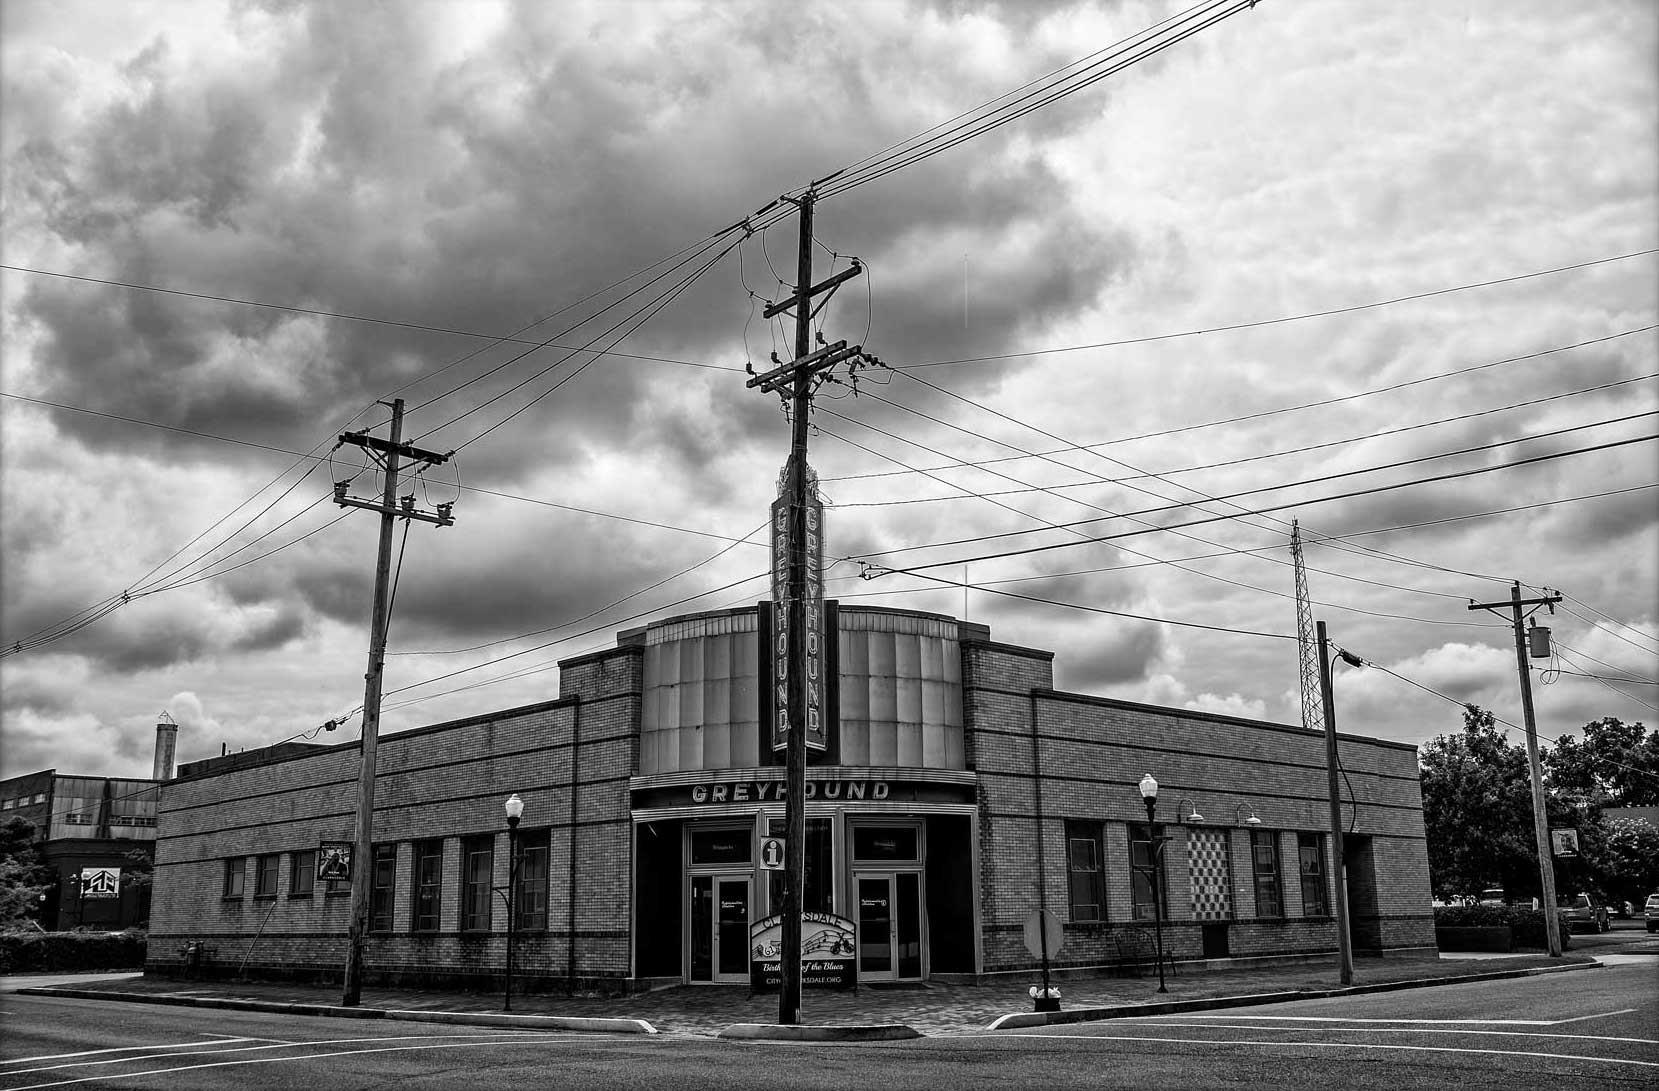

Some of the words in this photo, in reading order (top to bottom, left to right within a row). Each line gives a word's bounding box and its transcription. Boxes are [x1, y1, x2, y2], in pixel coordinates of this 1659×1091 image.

[776, 507, 788, 732] GREYHOUND
[806, 507, 819, 731] GREYHOUND
[801, 962, 811, 973] of
[811, 962, 822, 971] the
[822, 961, 844, 971] Blues
